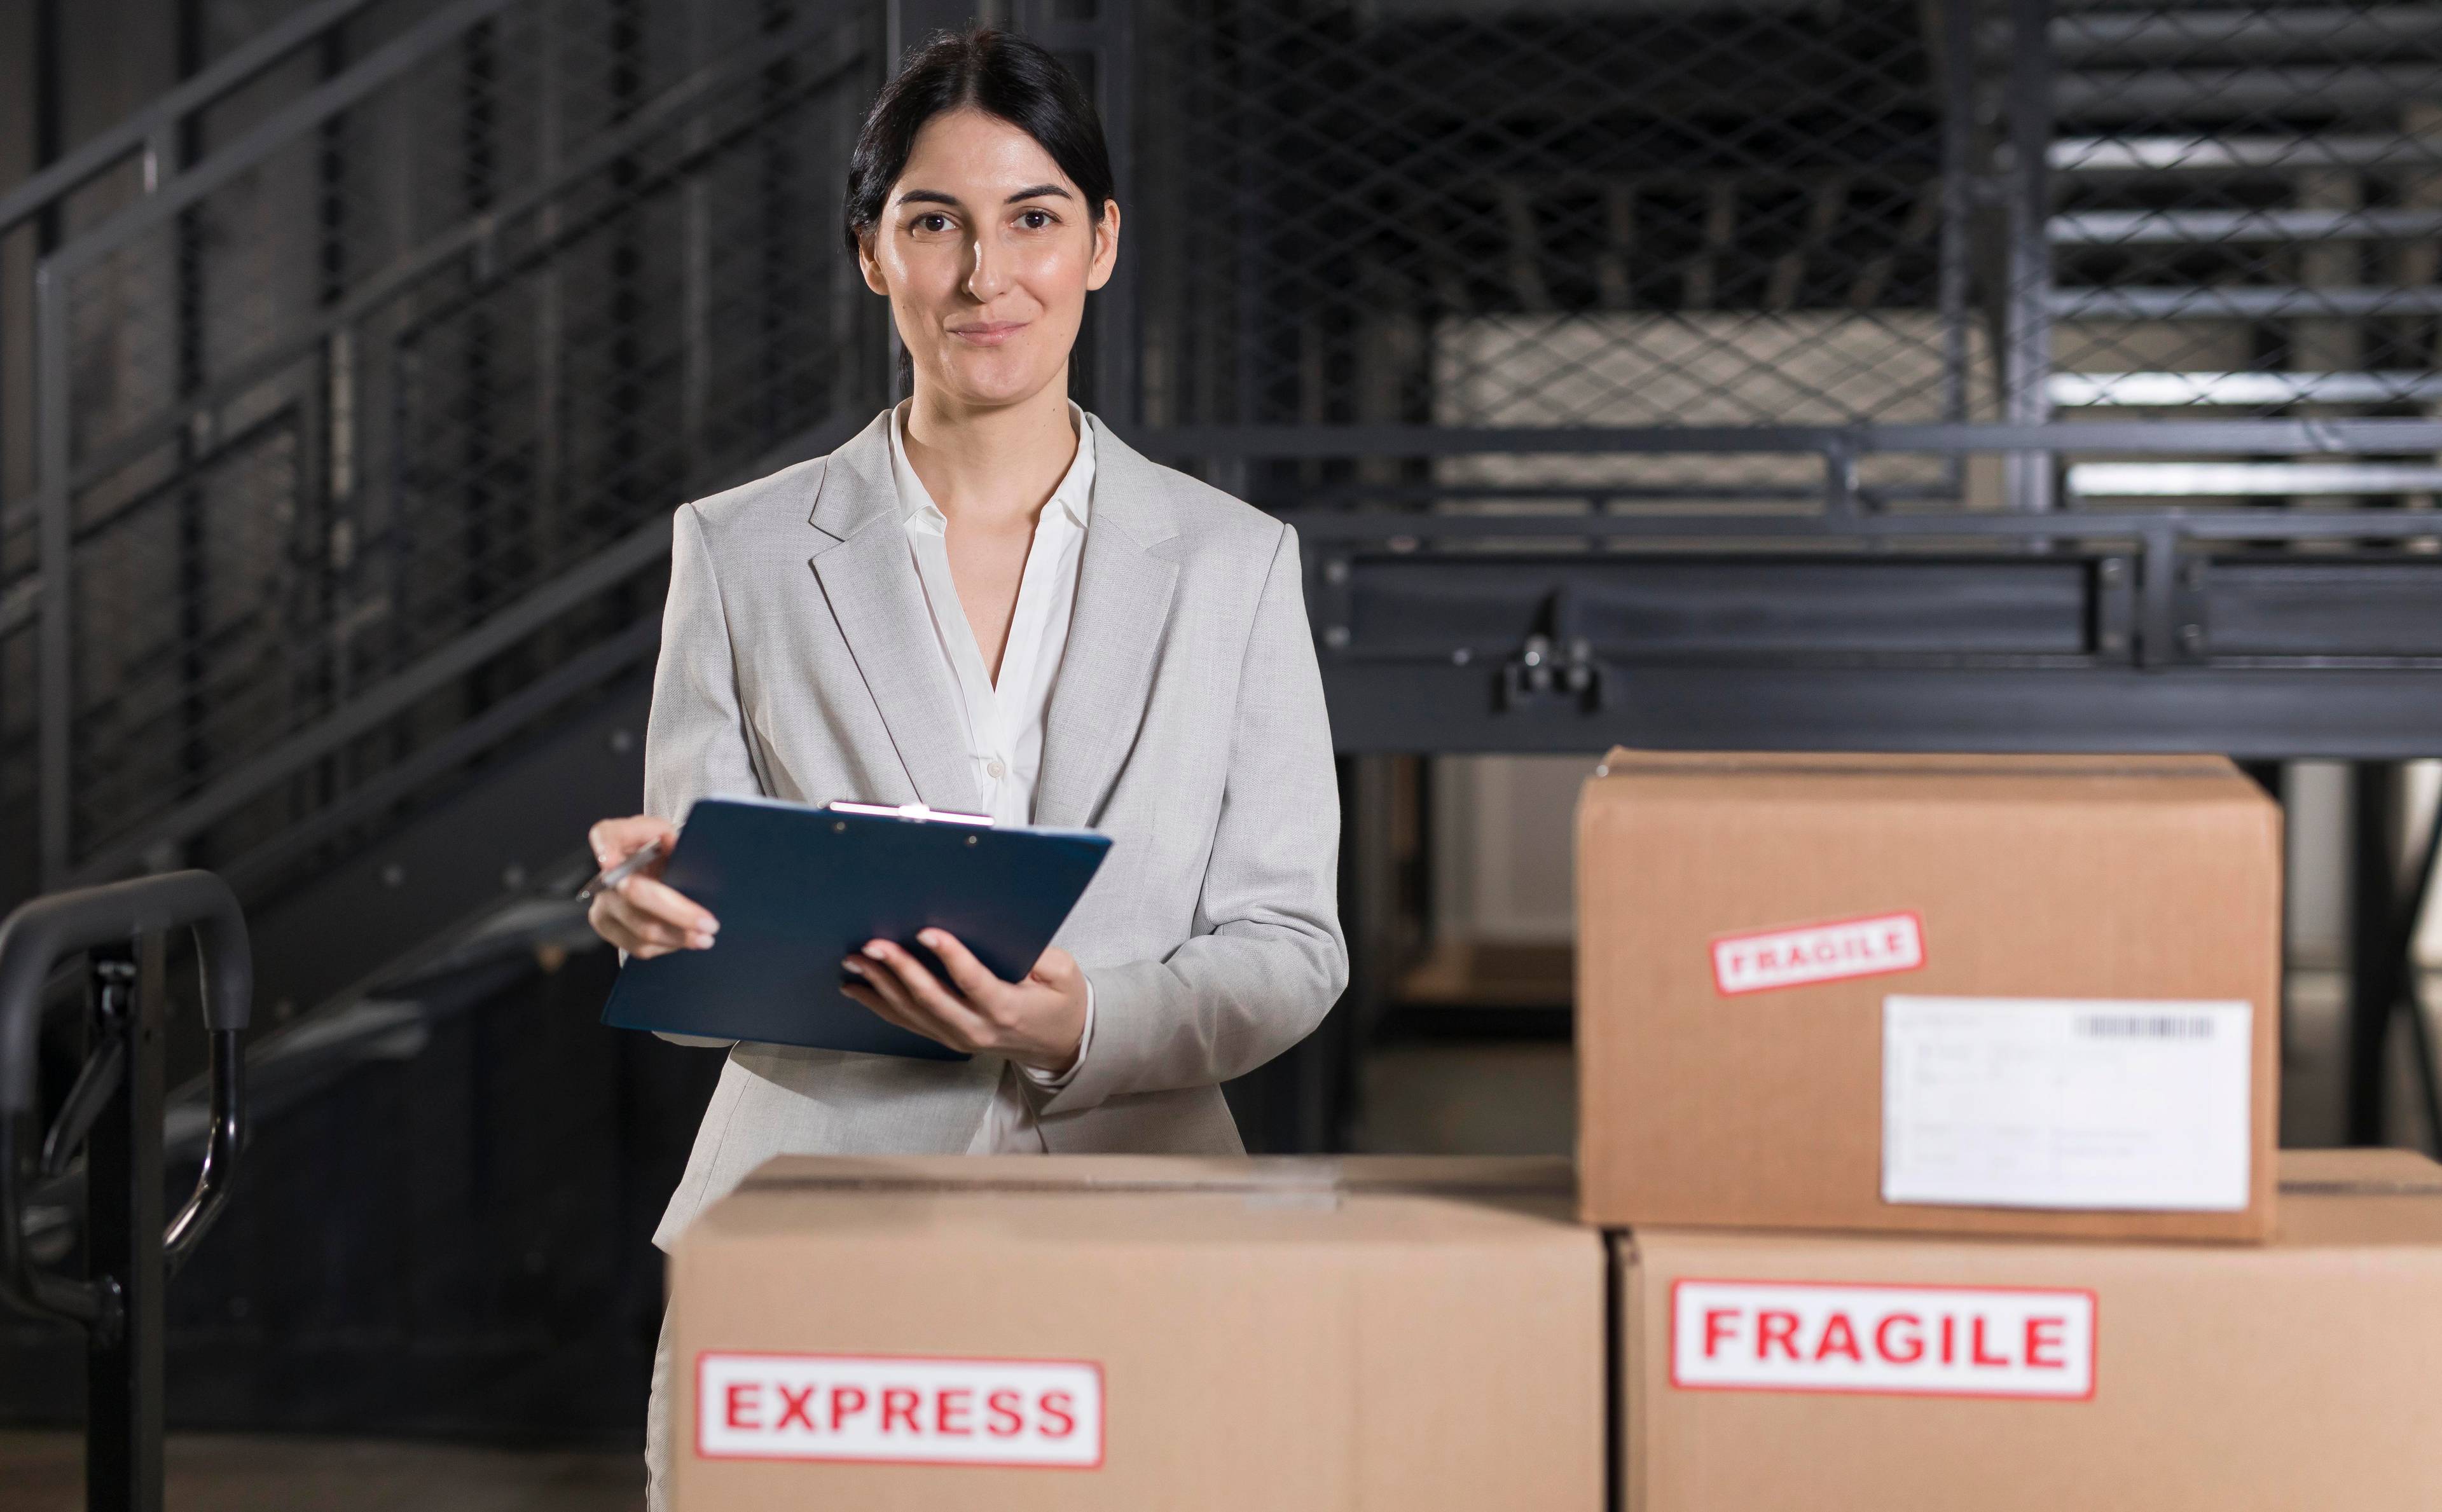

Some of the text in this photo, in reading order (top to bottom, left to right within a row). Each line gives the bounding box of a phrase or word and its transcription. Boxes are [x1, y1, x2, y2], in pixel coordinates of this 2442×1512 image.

[1731, 930, 1905, 973] FRAGILE
[1703, 1307, 2067, 1369] FRAGILE
[724, 1381, 1077, 1438] EXPRESS
